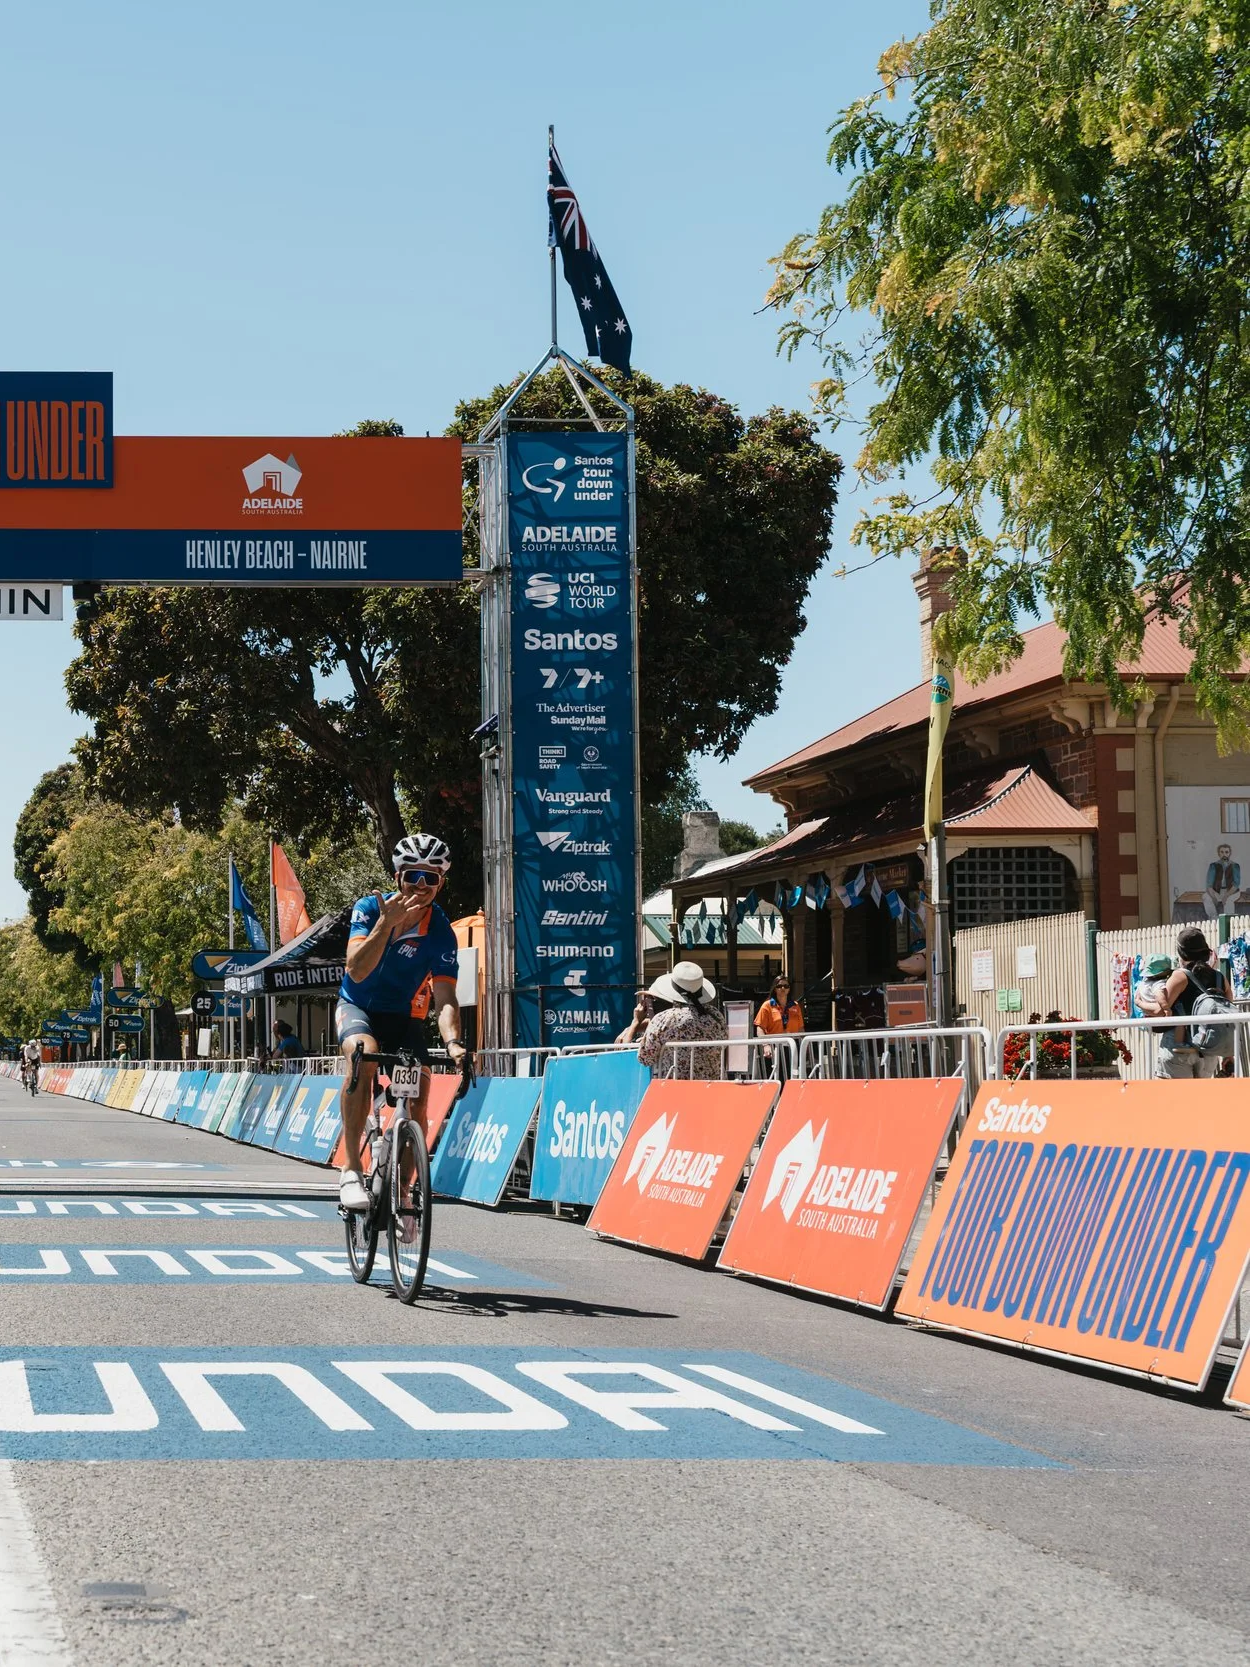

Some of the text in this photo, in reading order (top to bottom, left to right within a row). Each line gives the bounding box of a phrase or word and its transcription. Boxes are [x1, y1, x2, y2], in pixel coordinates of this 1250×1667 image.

[6, 400, 105, 480] UNDER
[574, 456, 614, 465] Santos
[583, 467, 613, 478] tour
[577, 478, 613, 489] down
[574, 490, 614, 501] under
[242, 498, 303, 509] ADELAIDE
[522, 527, 617, 543] ADELAIDE
[186, 540, 241, 569] HENLEY
[246, 540, 294, 569] BEACH
[311, 541, 367, 569] NAIRNE
[522, 544, 617, 552] SOUTH AUSTRALIA
[568, 573, 594, 584] UCI
[568, 586, 616, 596] WORLD
[568, 598, 605, 609] TOUR
[524, 629, 618, 650] Santos
[536, 703, 606, 712] The Advertiser
[551, 716, 606, 726] Sunday Mail
[535, 789, 611, 806] Vanguard
[562, 840, 610, 855] Ziptrak
[541, 910, 609, 925] Santini
[536, 946, 614, 957] SHIMANO
[274, 970, 304, 987] RIDE
[197, 998, 211, 1009] 25
[109, 1019, 119, 1027] 50
[558, 1011, 610, 1024] YAMAHA
[395, 1070, 418, 1085] 0330
[978, 1098, 1051, 1134] Santos
[448, 1111, 508, 1164] Santos
[550, 1100, 625, 1160] Santos
[655, 1149, 725, 1189] ADELAIDE
[647, 1184, 706, 1208] SOUTH AUSTRALIA
[806, 1165, 898, 1215] ADELAIDE
[797, 1209, 879, 1239] SOUTH AUSTRALIA
[918, 1139, 1250, 1353] TOUR DOWN UNDER
